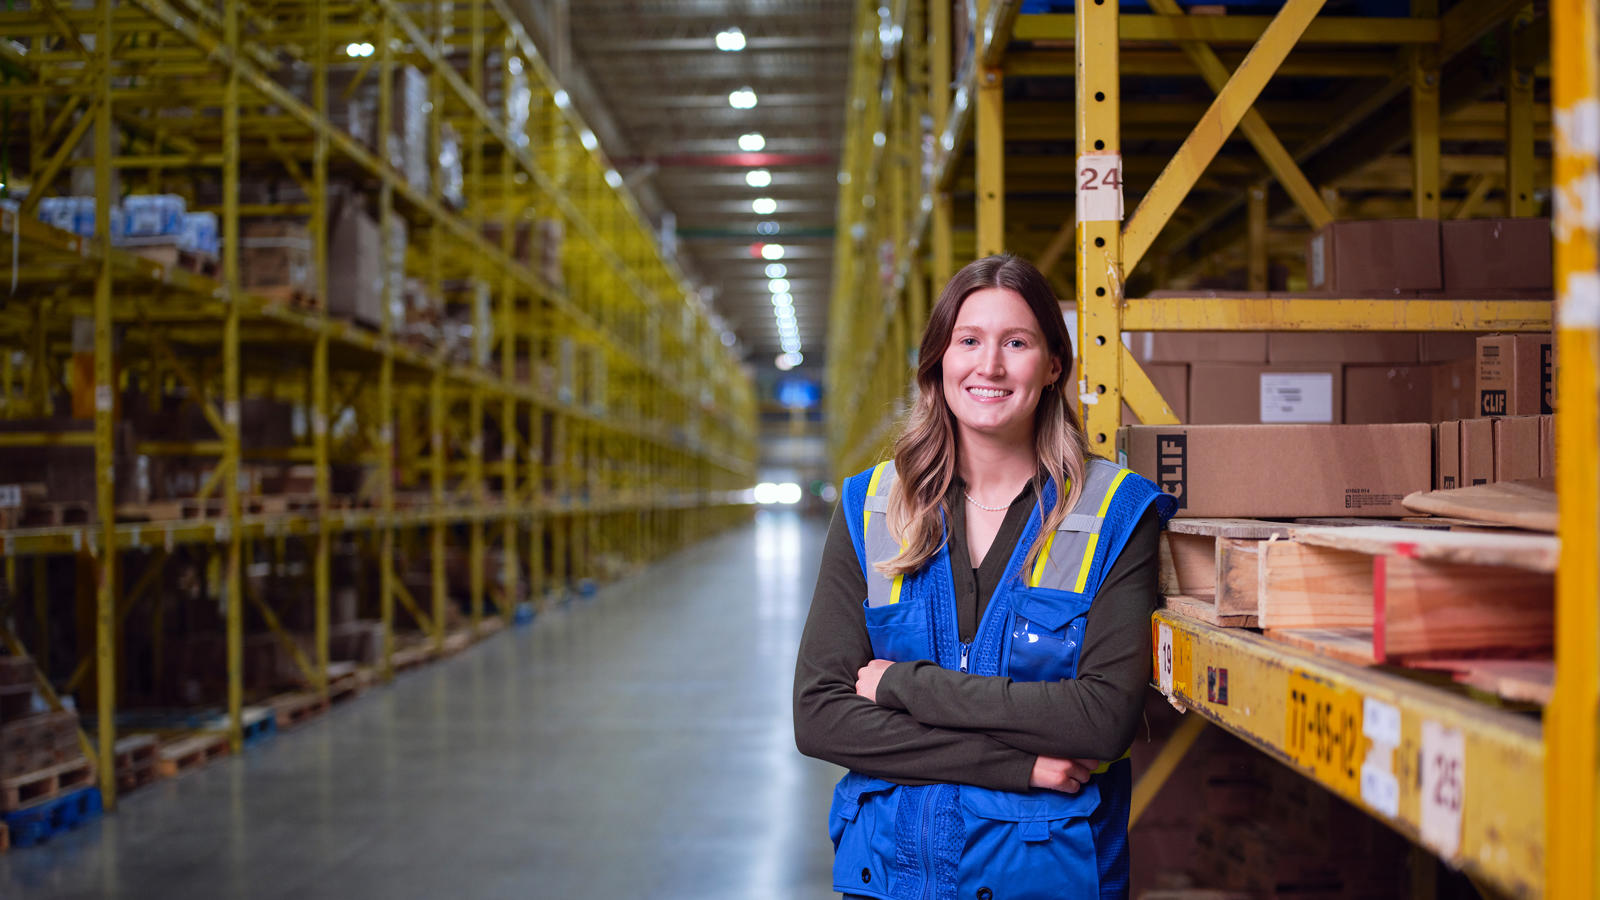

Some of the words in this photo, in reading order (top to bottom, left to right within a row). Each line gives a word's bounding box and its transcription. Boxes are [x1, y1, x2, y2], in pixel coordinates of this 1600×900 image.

[1080, 167, 1123, 190] 24
[1483, 394, 1505, 413] CLIF
[1161, 440, 1183, 498] CLIF
[1163, 641, 1172, 675] 19
[1433, 753, 1462, 812] 25
